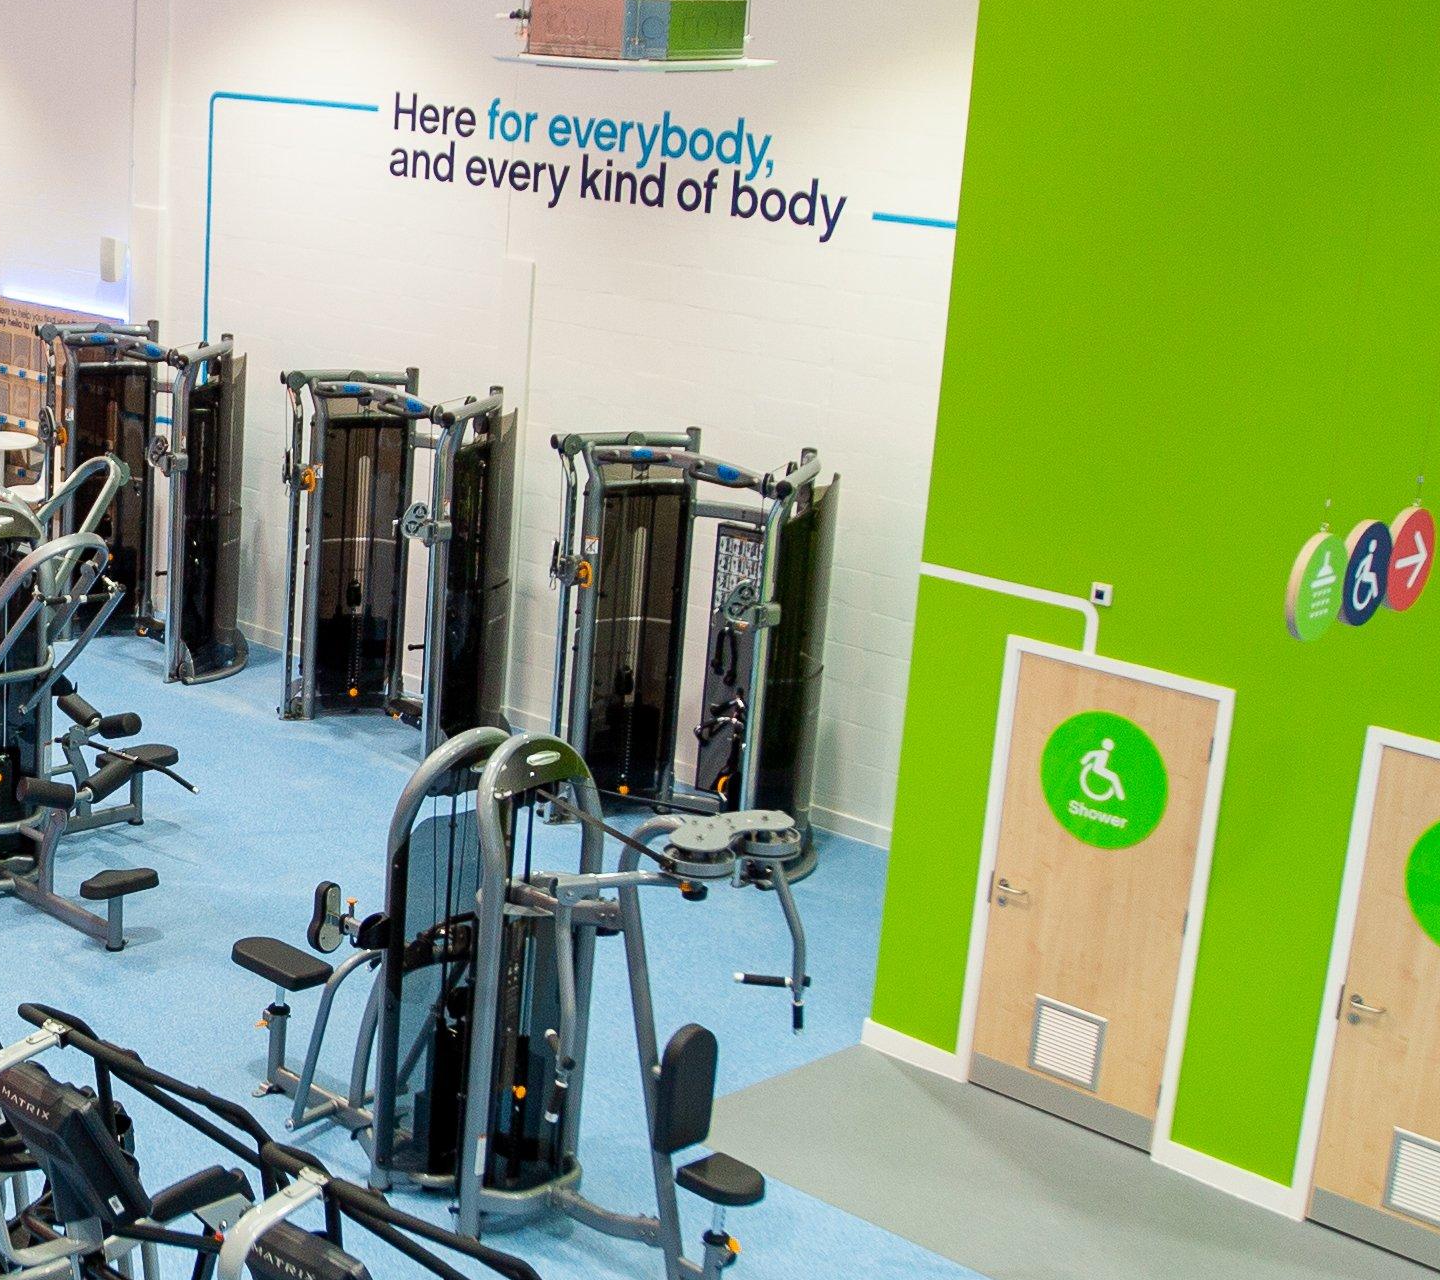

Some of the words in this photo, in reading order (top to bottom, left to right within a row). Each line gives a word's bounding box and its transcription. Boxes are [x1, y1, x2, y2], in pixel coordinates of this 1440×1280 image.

[392, 91, 476, 137] Here
[487, 98, 538, 144] for
[548, 111, 774, 180] everybody,
[388, 142, 456, 183] and
[466, 151, 570, 209] every
[579, 154, 666, 208] kind
[677, 170, 718, 214] of
[731, 170, 848, 243] body
[1067, 798, 1128, 830] Shower
[0, 1084, 51, 1121] MATRIX
